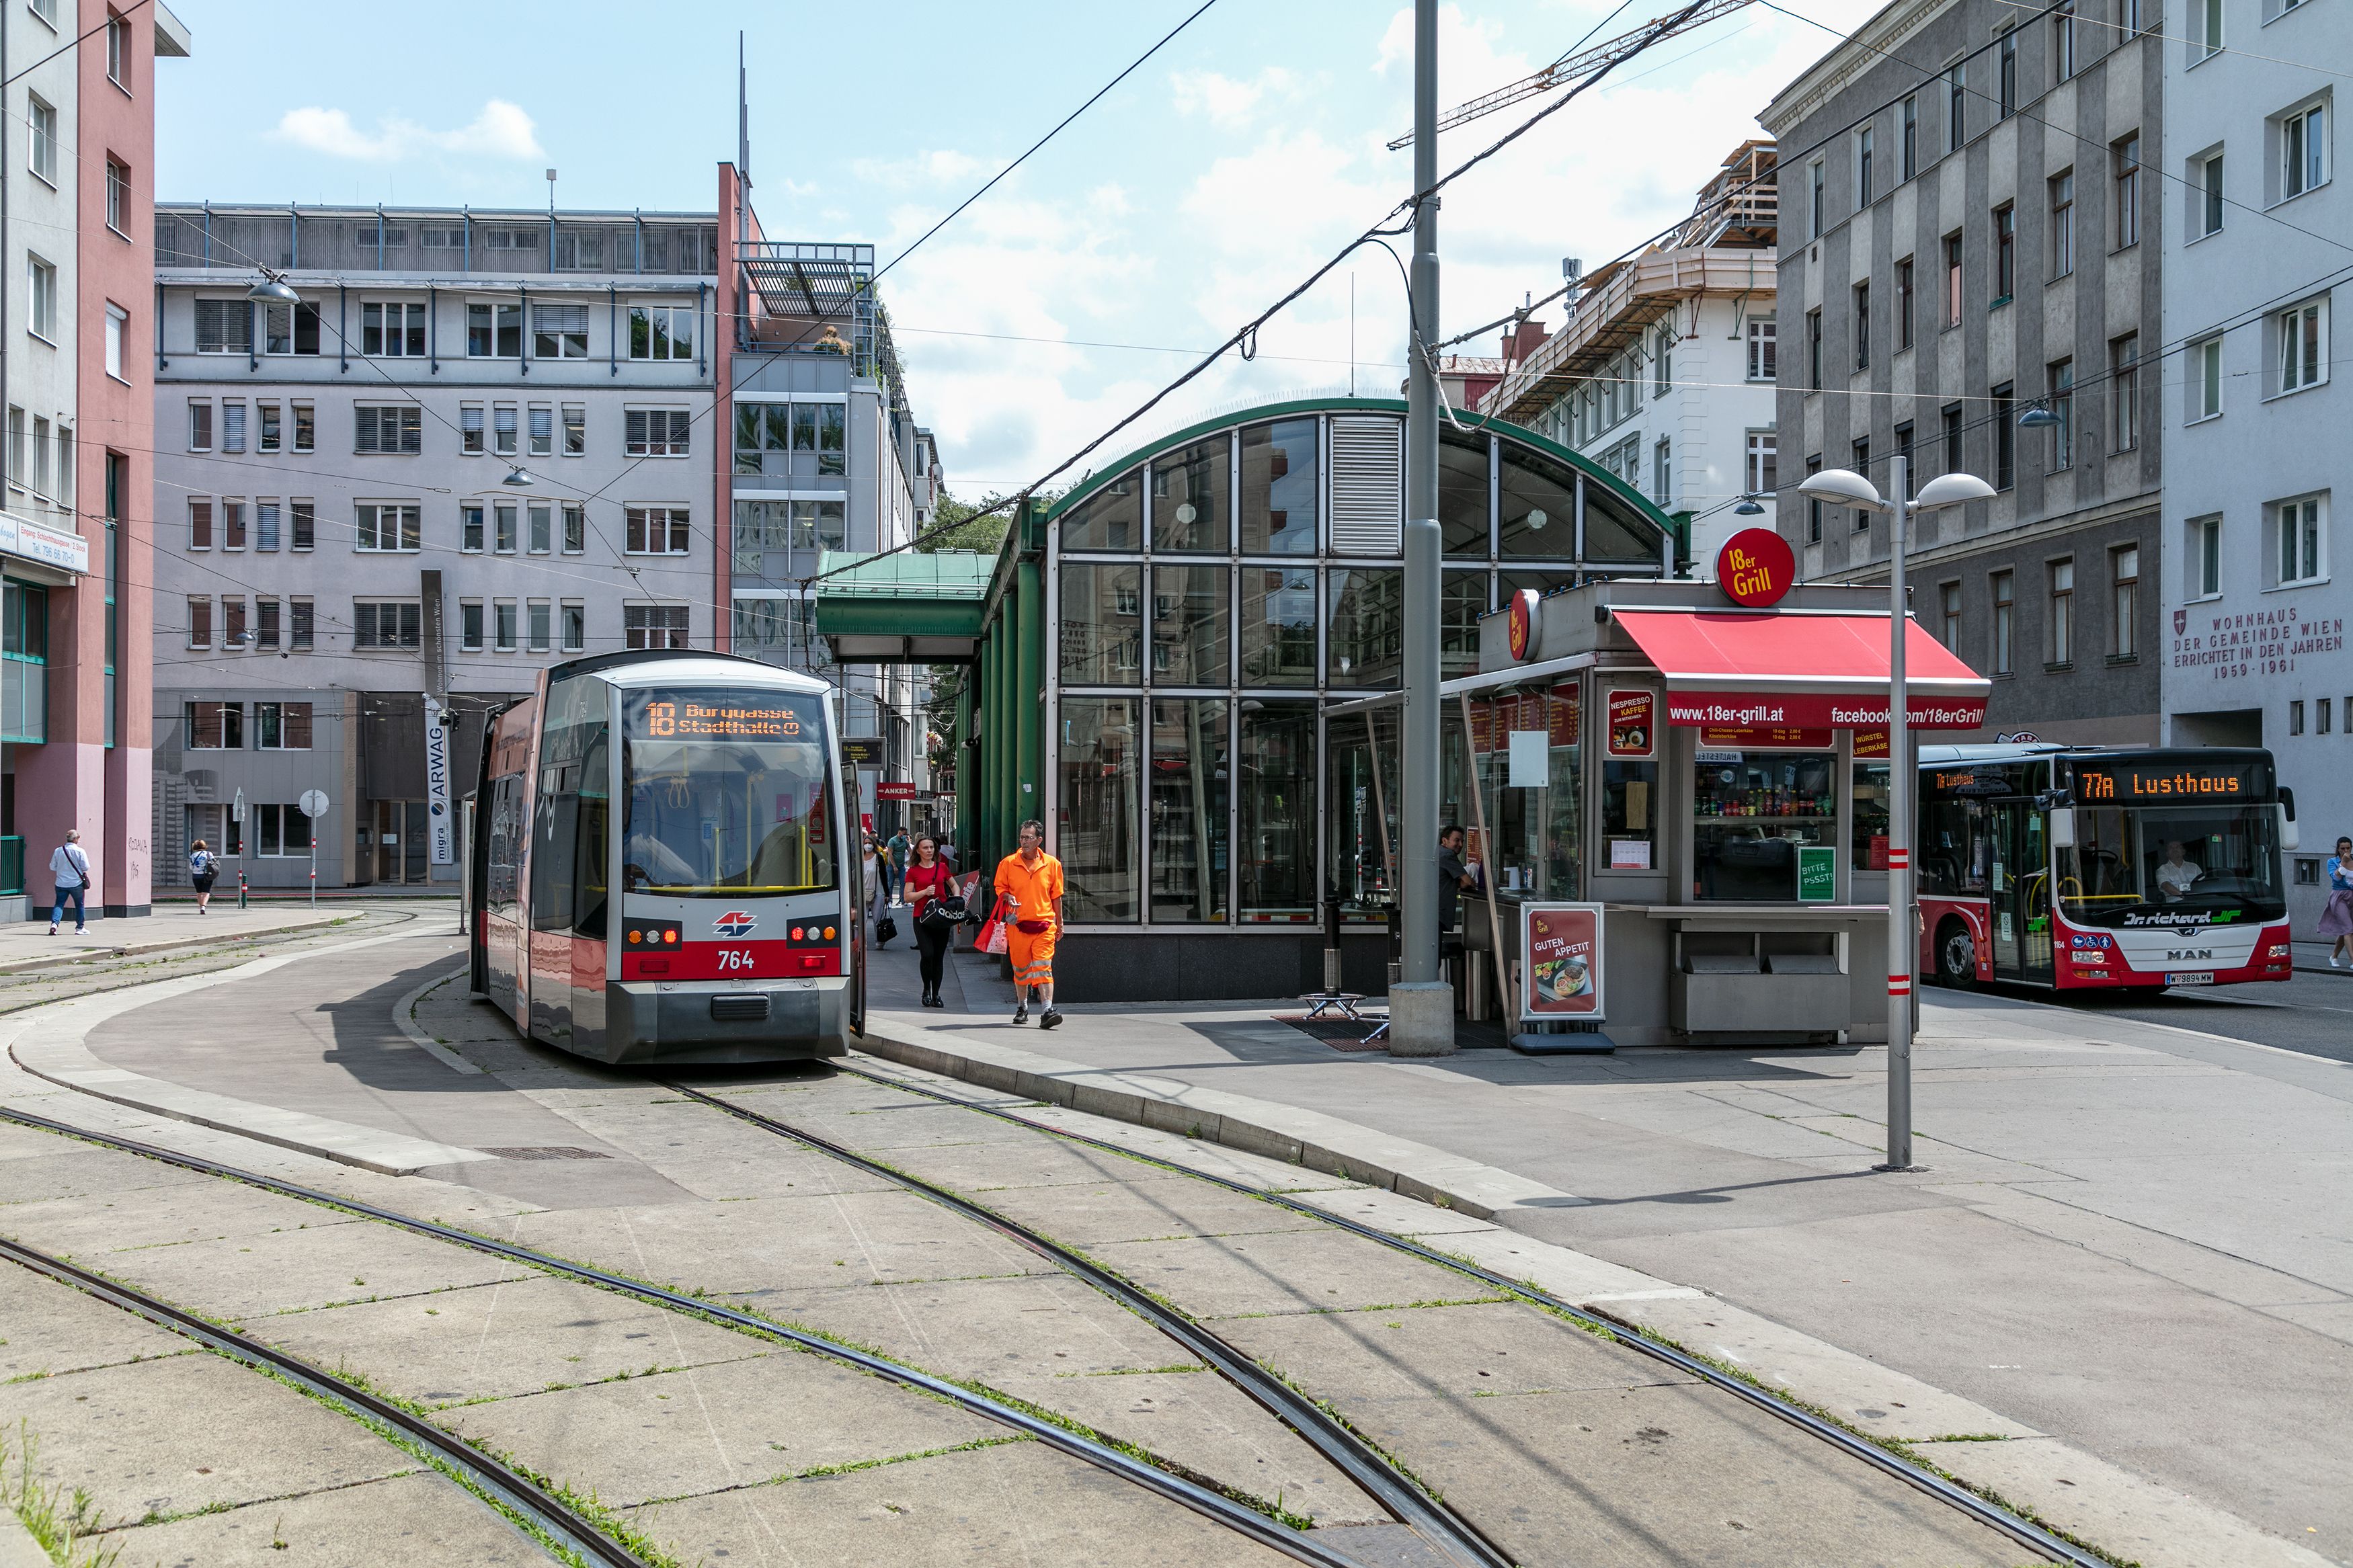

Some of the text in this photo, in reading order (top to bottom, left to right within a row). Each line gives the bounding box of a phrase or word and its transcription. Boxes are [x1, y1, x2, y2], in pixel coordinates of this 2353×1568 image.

[43, 545, 52, 557] 796
[54, 548, 61, 560] 66
[1733, 567, 1772, 596] Grill
[2212, 608, 2297, 630] WOHNHAUS
[1512, 624, 1522, 651] Grill
[2173, 618, 2342, 652] DER GEMEINDE WIEN
[436, 654, 442, 664] im
[2173, 636, 2342, 667] ERRICHTET IN DEN JAHREN
[2214, 663, 2247, 679] 1959
[2260, 658, 2295, 674] 1961
[1610, 696, 1650, 710] NESPRESSO
[1620, 705, 1647, 716] KAFFEE
[1670, 706, 1784, 724] www.18er-grill.at
[1831, 707, 1984, 724] facebookom/18erGrill
[1856, 731, 1884, 743] WÜRSTEL
[1853, 742, 1888, 755] LEBERKÄSE
[430, 727, 444, 797] ARWAG
[1946, 772, 1975, 786] Lusthaus
[2083, 772, 2239, 798] 77A Lusthaus
[436, 827, 446, 860] migra
[1802, 863, 1827, 875] BITTE
[1804, 872, 1833, 886] PSSST!
[938, 907, 965, 919] adidas
[2146, 911, 2212, 925] richard
[1538, 925, 1549, 934] Grill
[1534, 937, 1564, 952] GUTEN
[1554, 942, 1589, 958] APPETIT
[718, 950, 754, 970] 764
[2167, 949, 2212, 960] MAN
[2171, 974, 2212, 983] W 9894 MW
